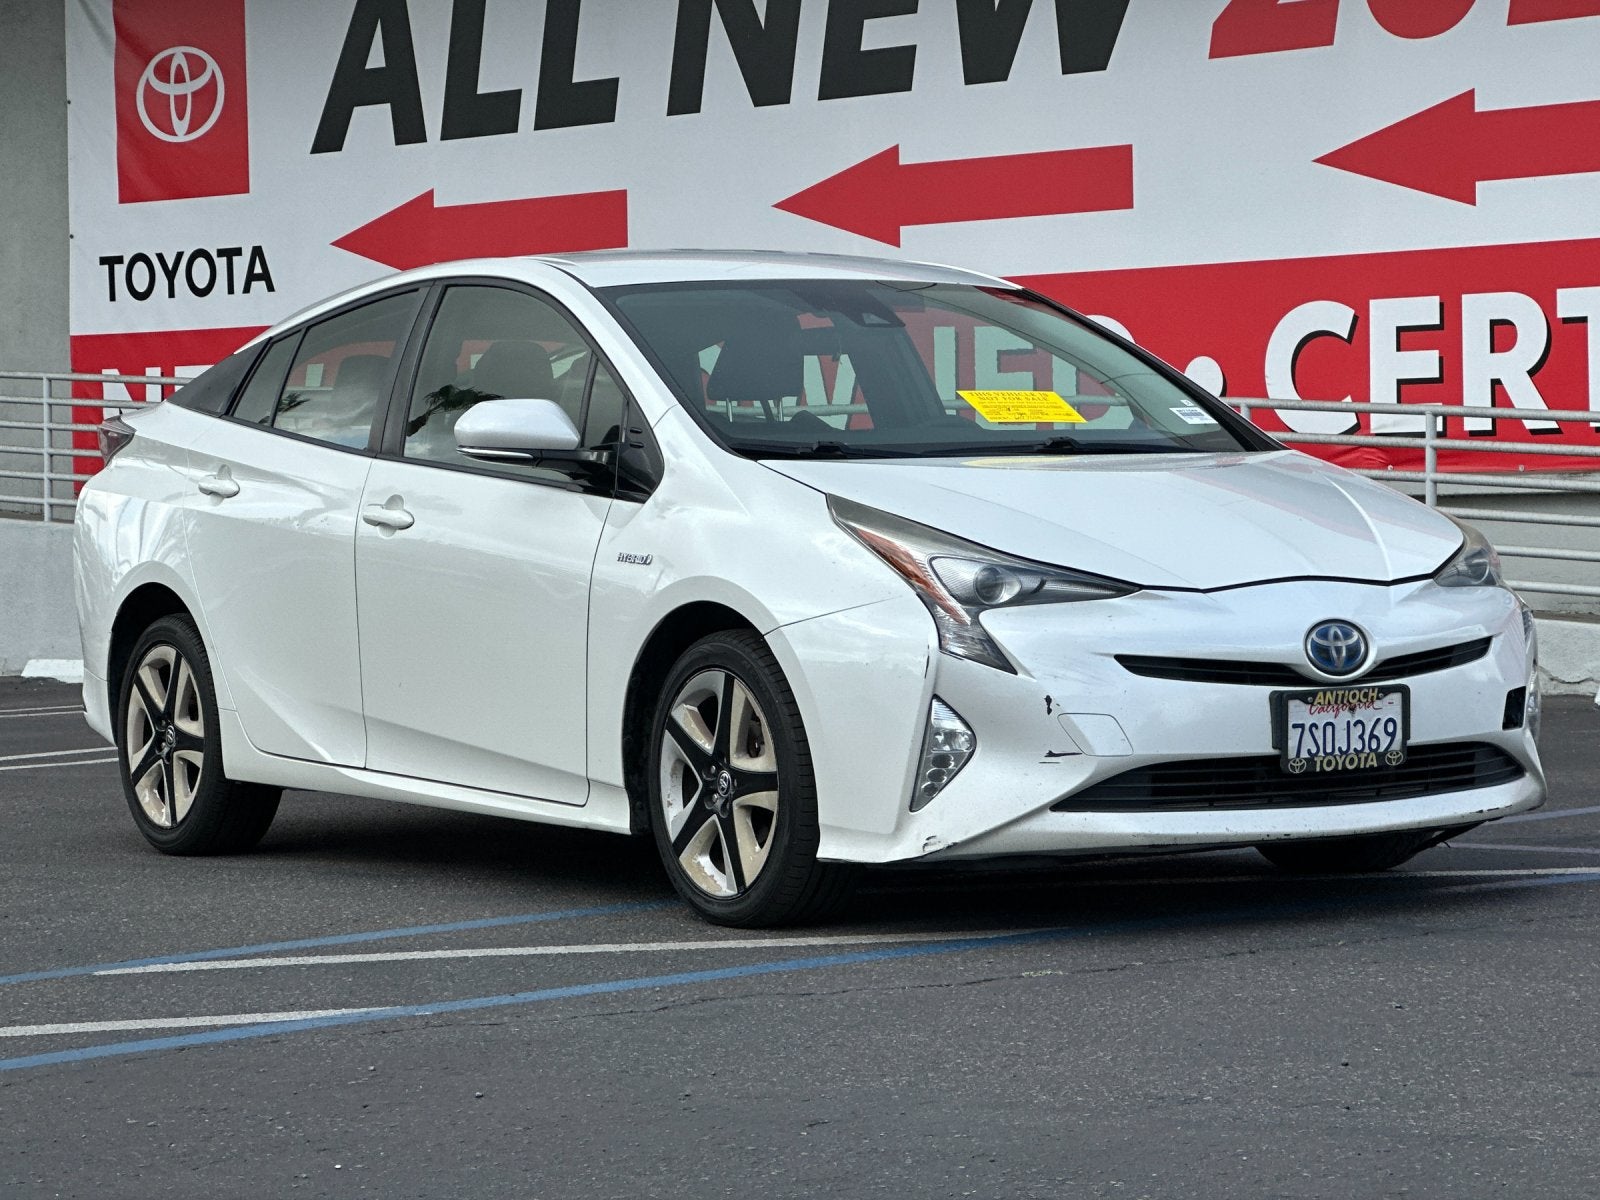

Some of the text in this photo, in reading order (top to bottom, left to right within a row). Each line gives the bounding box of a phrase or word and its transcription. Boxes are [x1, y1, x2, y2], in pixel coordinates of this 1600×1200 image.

[310, 0, 619, 154] ALL
[99, 245, 276, 302] TOYOTA
[1314, 688, 1378, 705] ANTIOCH
[1314, 751, 1378, 772] TOYOTA
